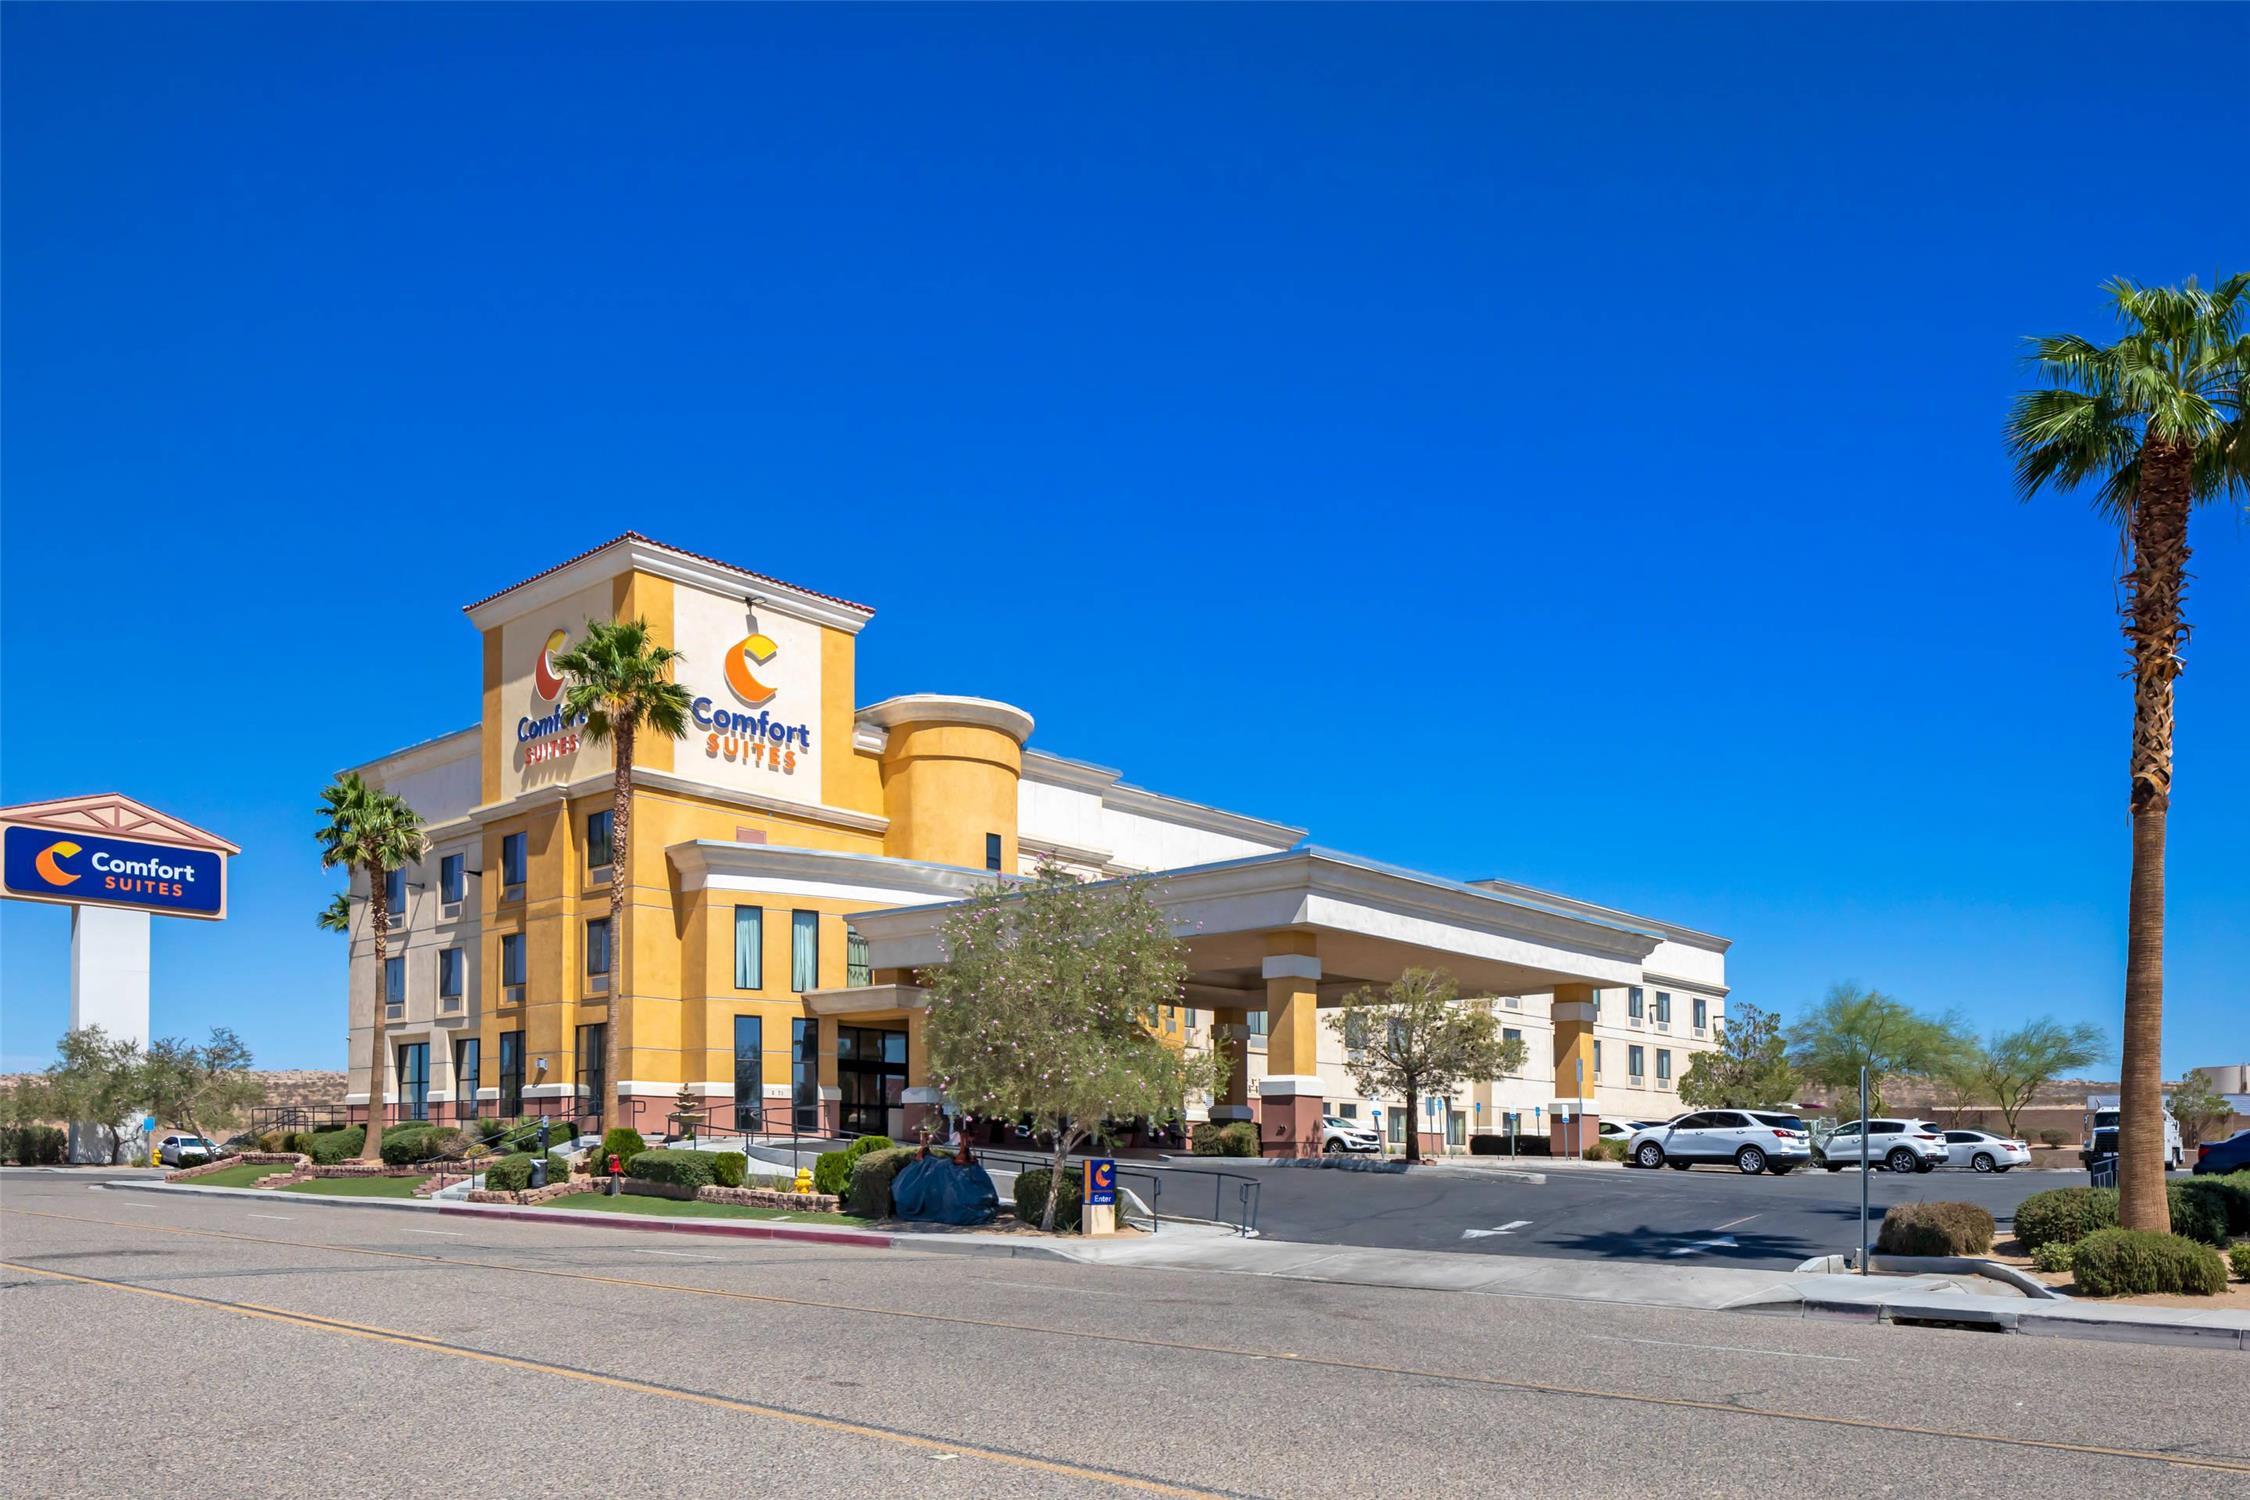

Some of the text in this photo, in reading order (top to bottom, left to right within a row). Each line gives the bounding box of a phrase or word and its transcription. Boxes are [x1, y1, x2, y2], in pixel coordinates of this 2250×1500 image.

[692, 696, 810, 748] Comfort
[525, 734, 578, 765] SUITES
[706, 733, 796, 769] SUITES
[91, 852, 195, 882] Comfort
[104, 876, 183, 897] SUITES
[1094, 1194, 1112, 1203] Enter
